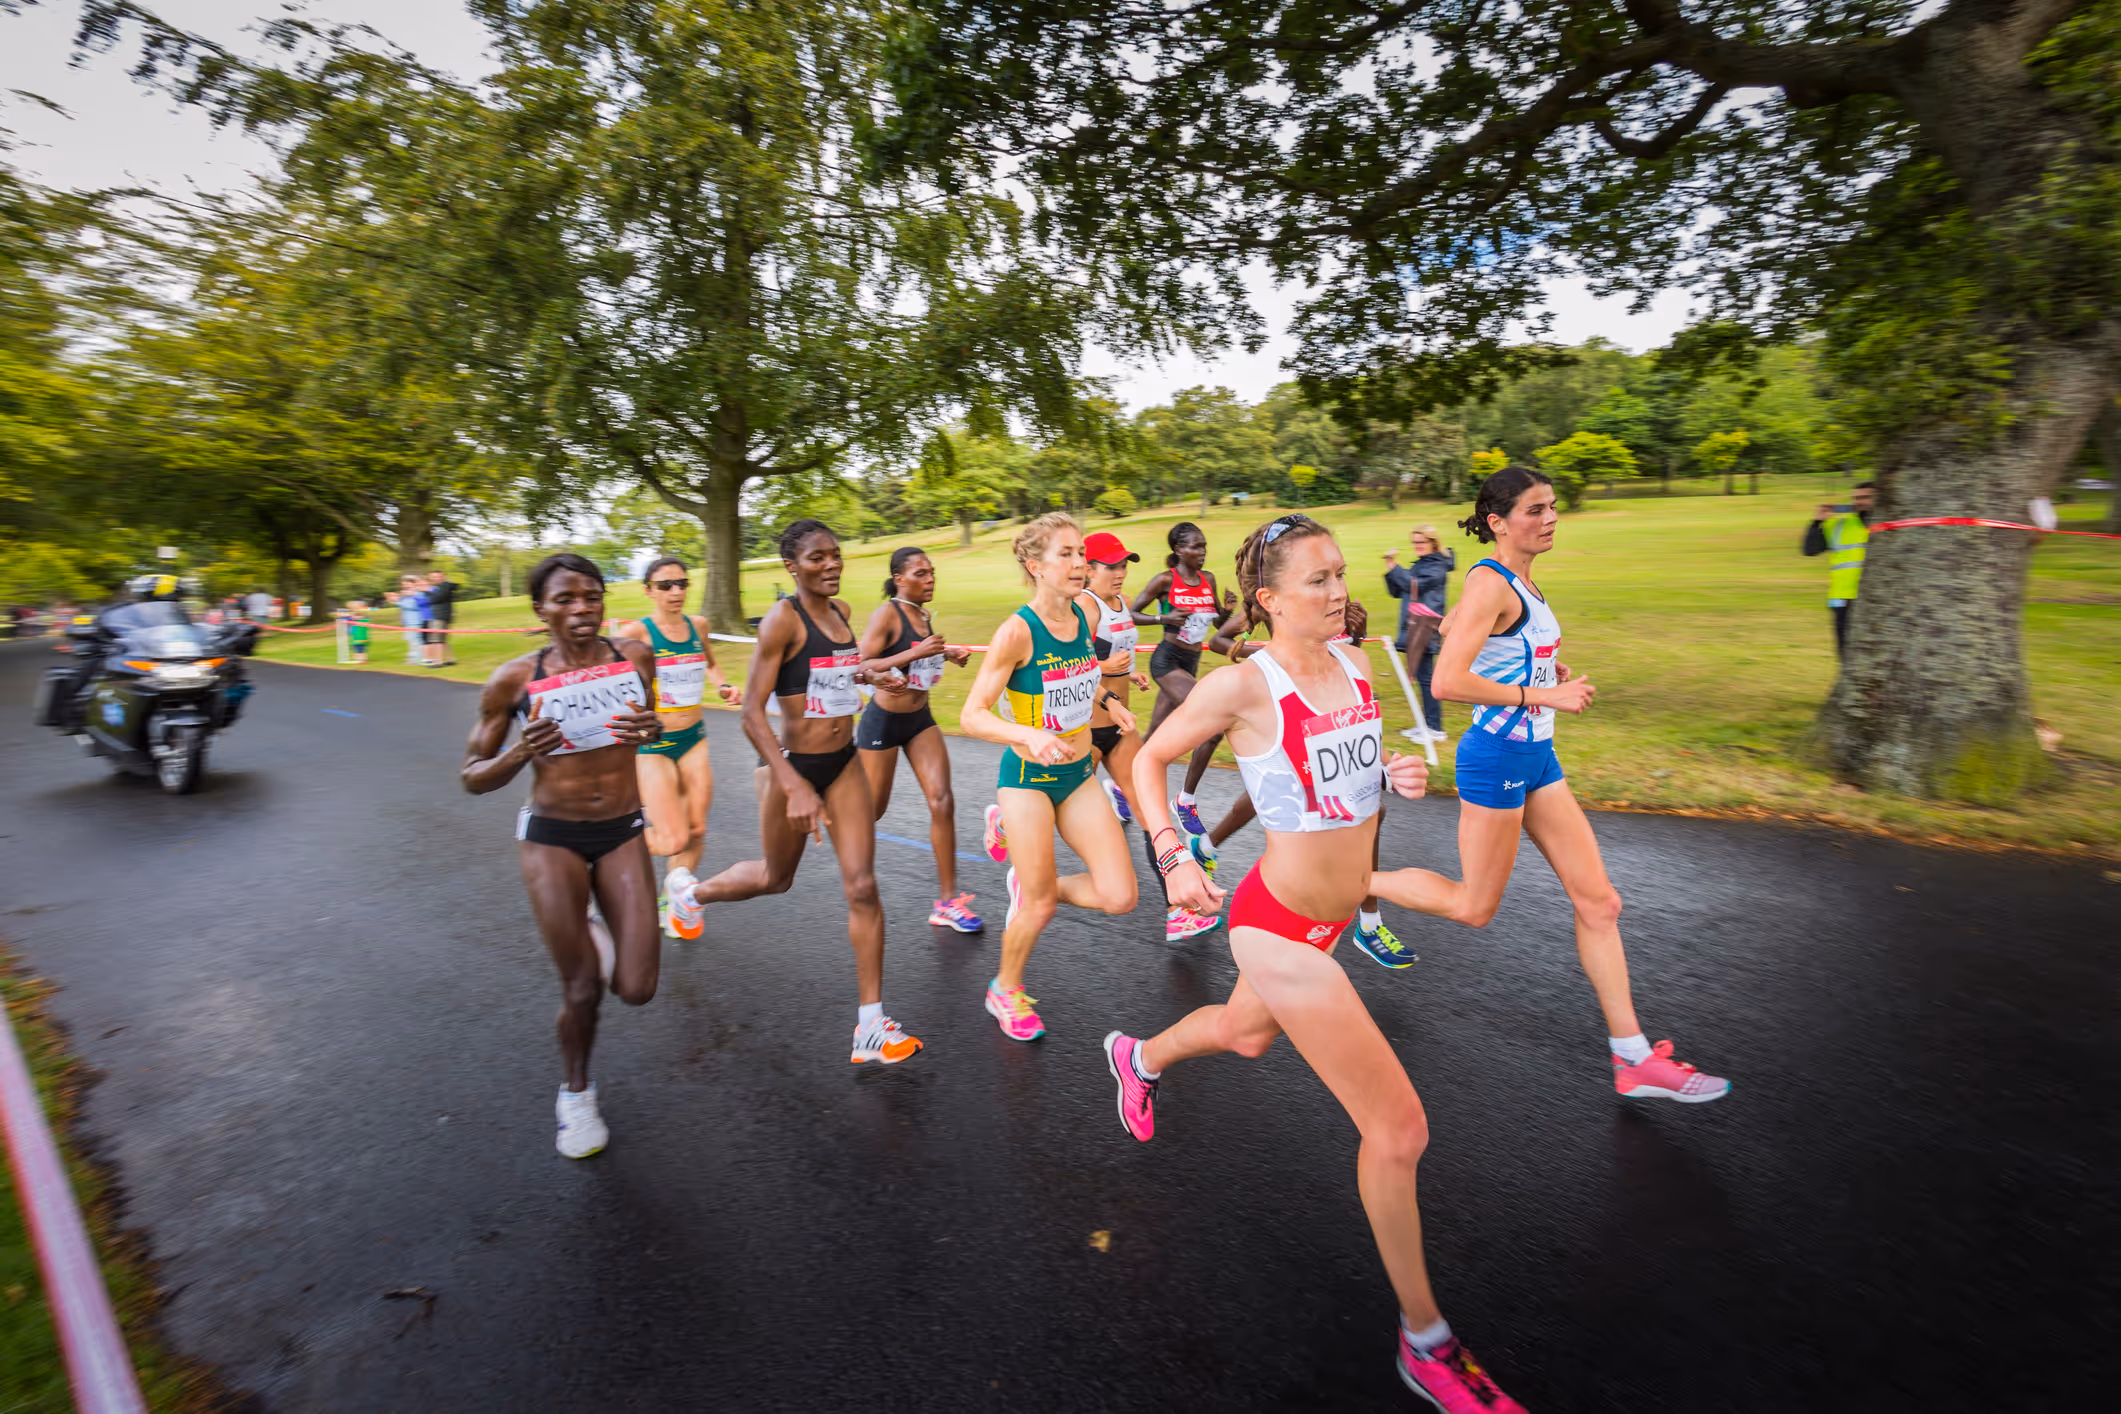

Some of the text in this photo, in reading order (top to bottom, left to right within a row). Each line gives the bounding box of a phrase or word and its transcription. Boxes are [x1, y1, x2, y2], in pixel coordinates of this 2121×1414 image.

[1036, 655, 1062, 666] DIADORA
[1049, 653, 1096, 672] AUSTRAL
[550, 681, 639, 723] OHANNES
[1317, 733, 1382, 783] DIXO
